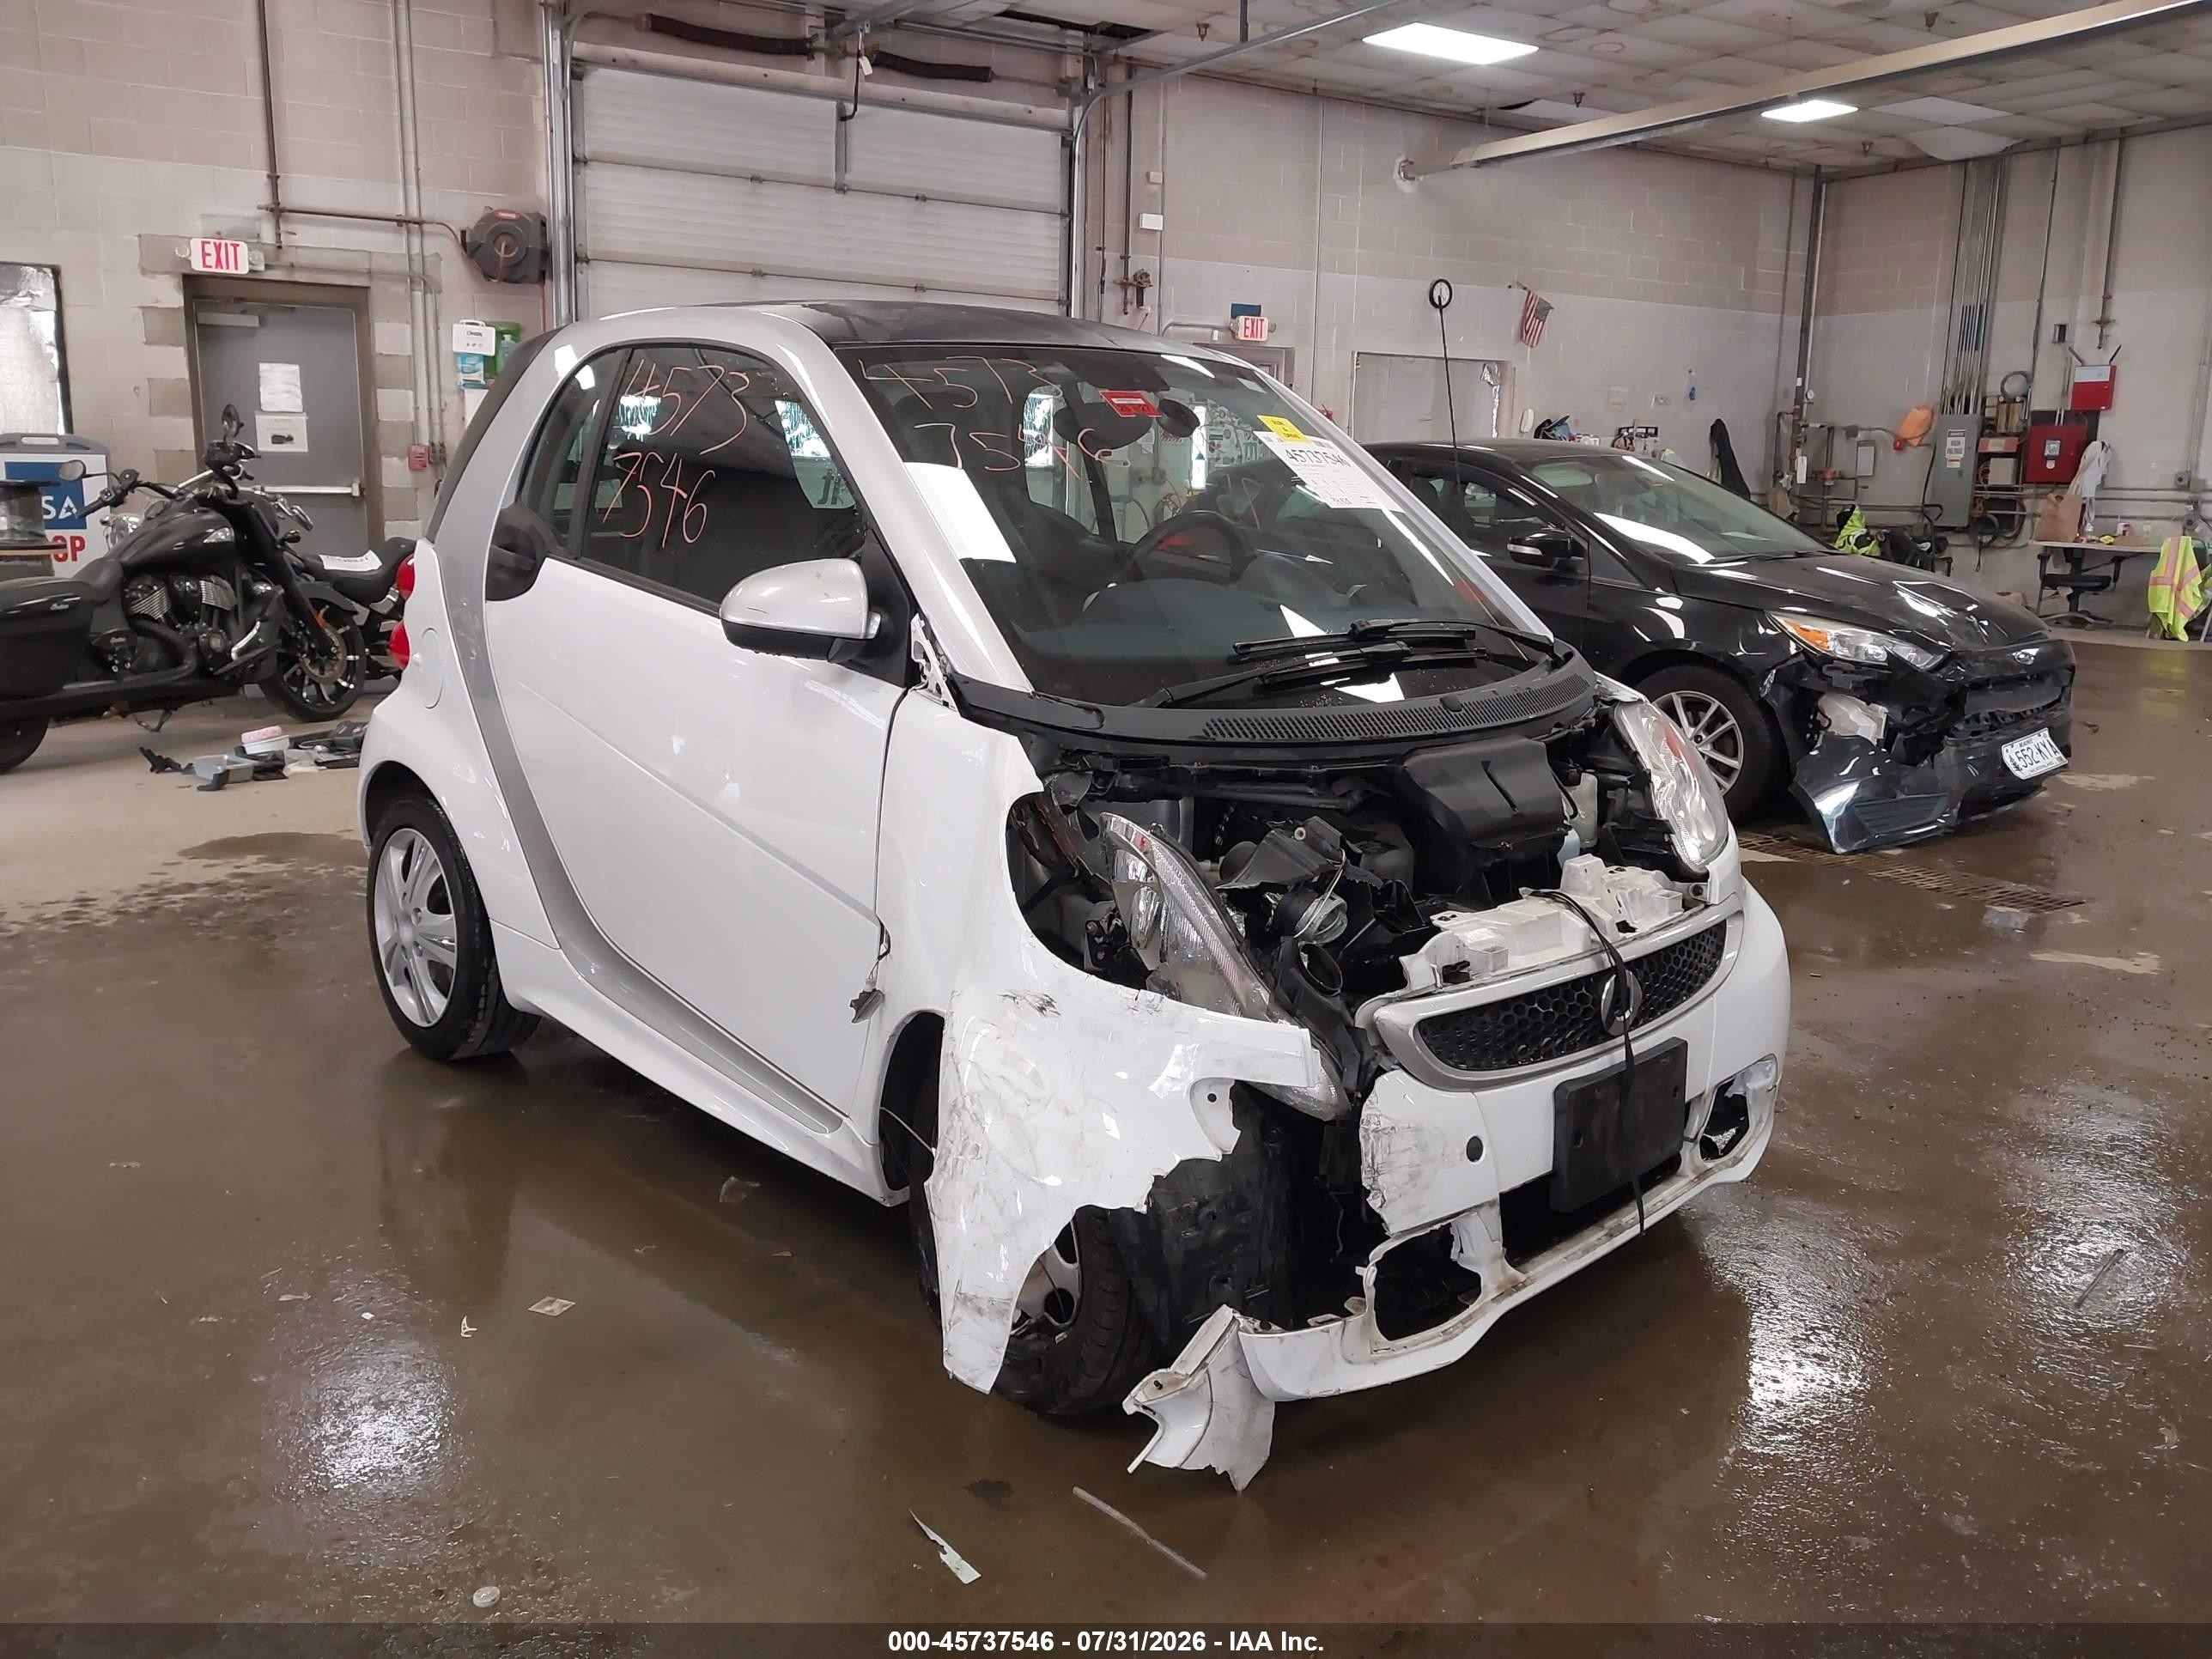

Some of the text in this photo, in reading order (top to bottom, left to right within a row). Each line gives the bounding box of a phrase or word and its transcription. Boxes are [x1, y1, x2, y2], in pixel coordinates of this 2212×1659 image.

[201, 240, 240, 270] EXIT
[1243, 317, 1265, 338] EXIT
[859, 356, 1062, 410] 4573
[624, 358, 750, 455] 4573
[1285, 448, 1352, 468] 45737546
[41, 495, 78, 520] SA
[602, 452, 716, 550] 7546
[52, 535, 86, 562] OP
[2014, 746, 2040, 769] 552
[2033, 738, 2060, 760] KYA
